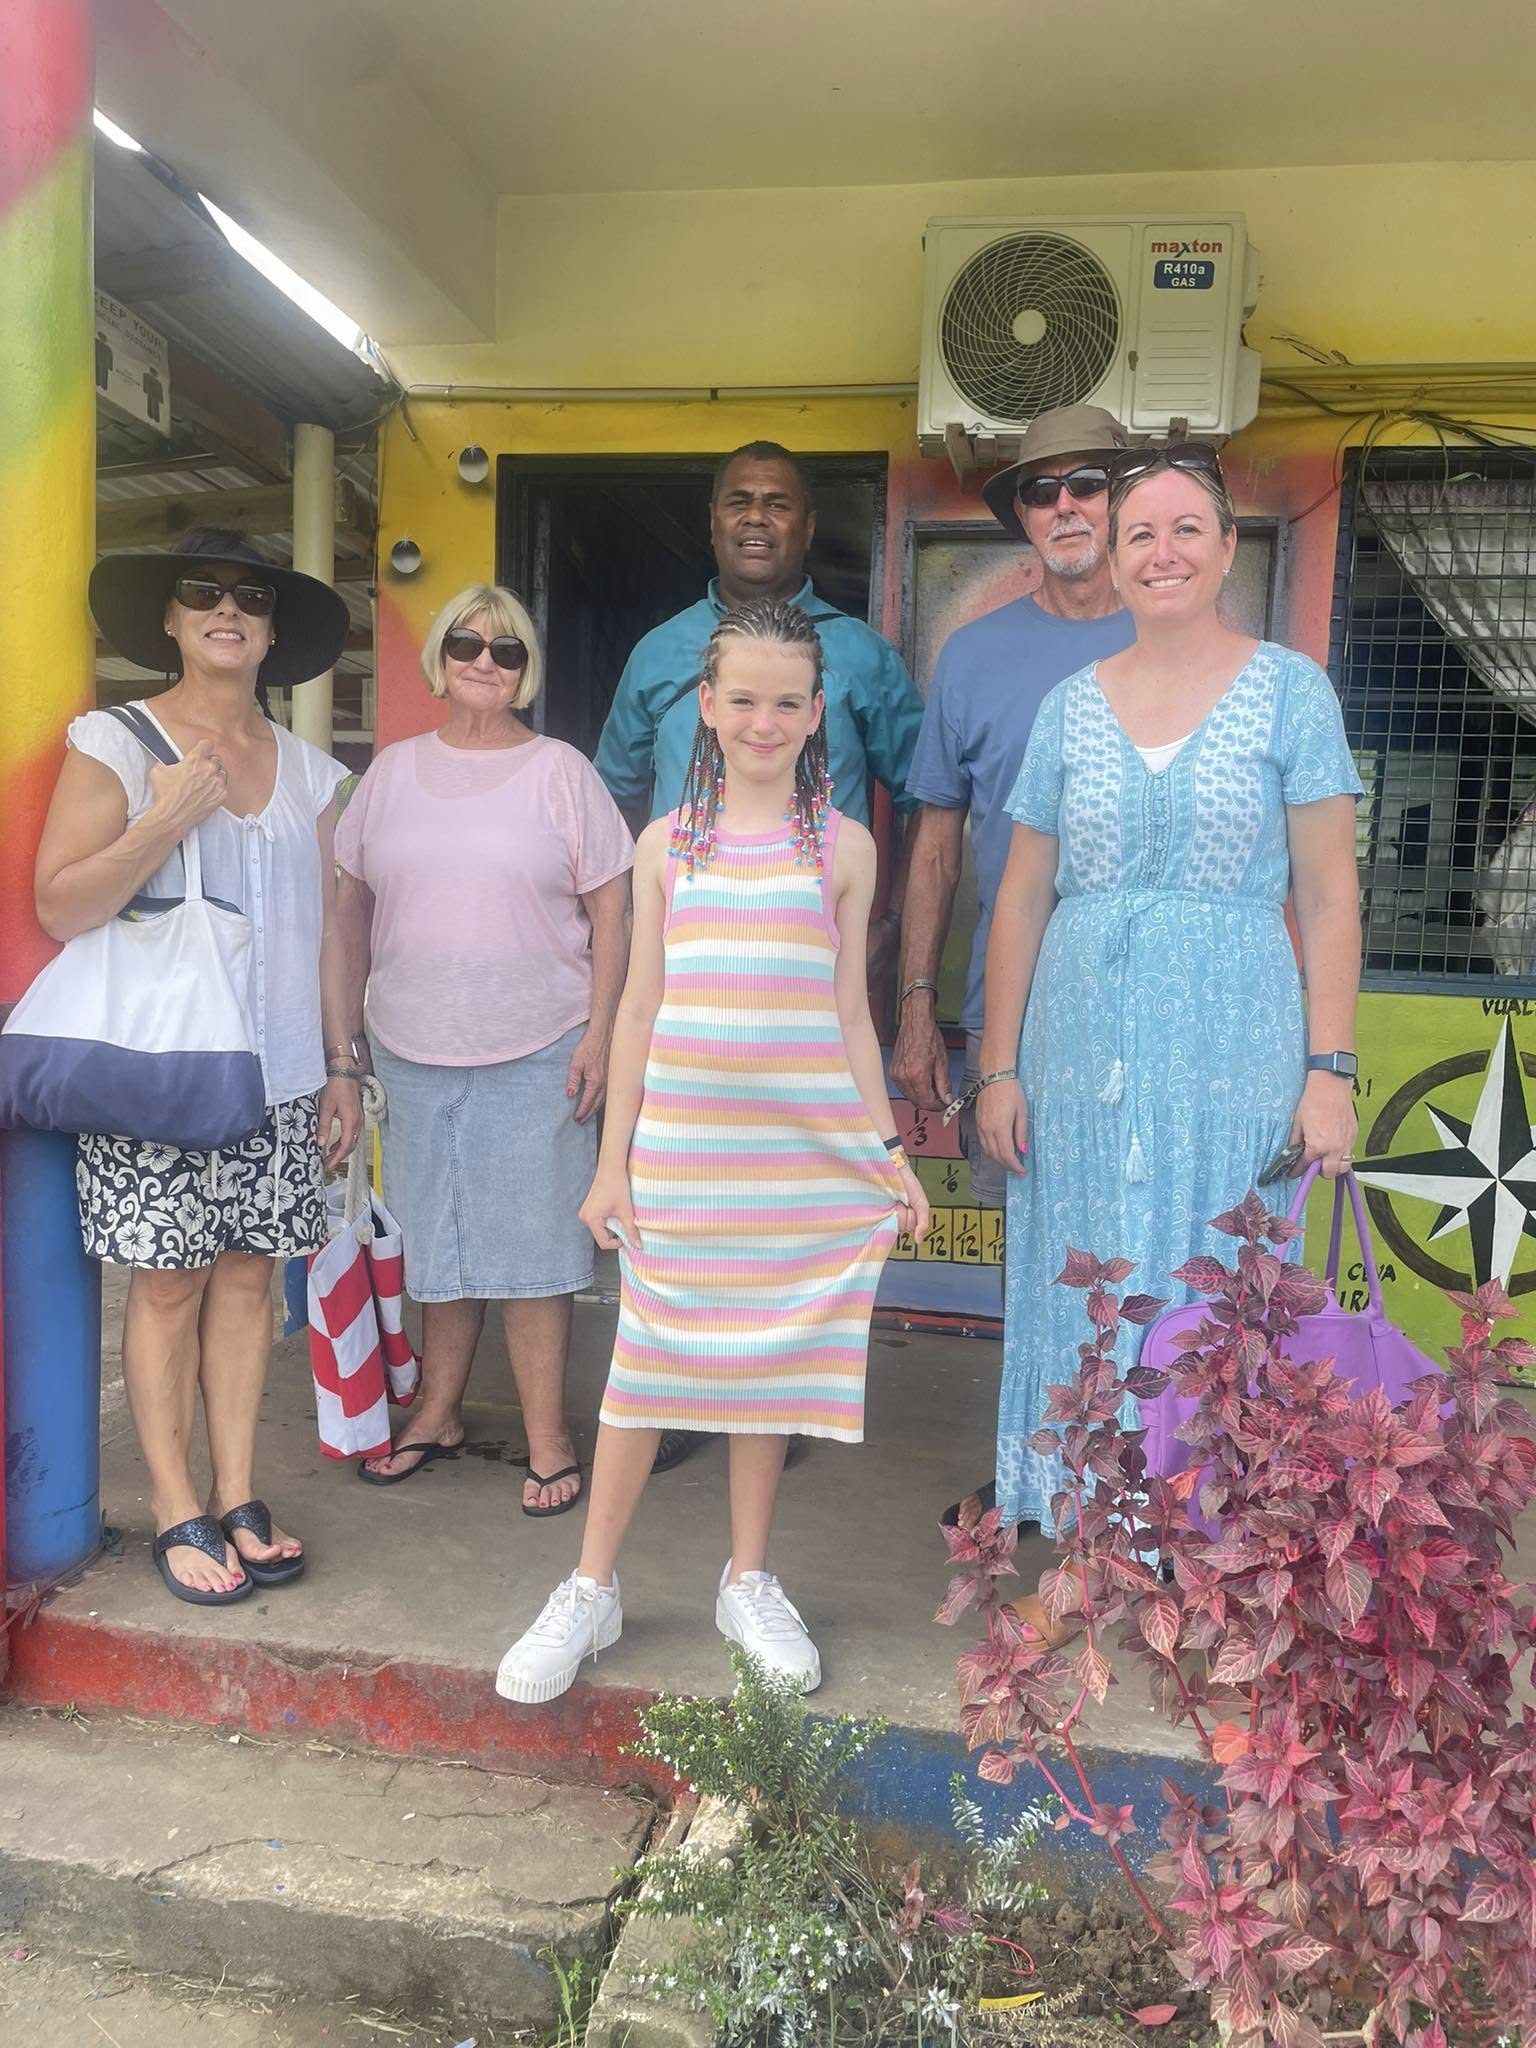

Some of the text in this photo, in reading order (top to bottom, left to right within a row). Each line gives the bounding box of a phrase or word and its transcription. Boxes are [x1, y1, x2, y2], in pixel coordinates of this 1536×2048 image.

[1151, 240, 1223, 258] maxton
[1163, 263, 1206, 275] R410a
[1171, 278, 1196, 287] GAS
[95, 290, 128, 318] EEP
[1482, 999, 1536, 1016] VUAL
